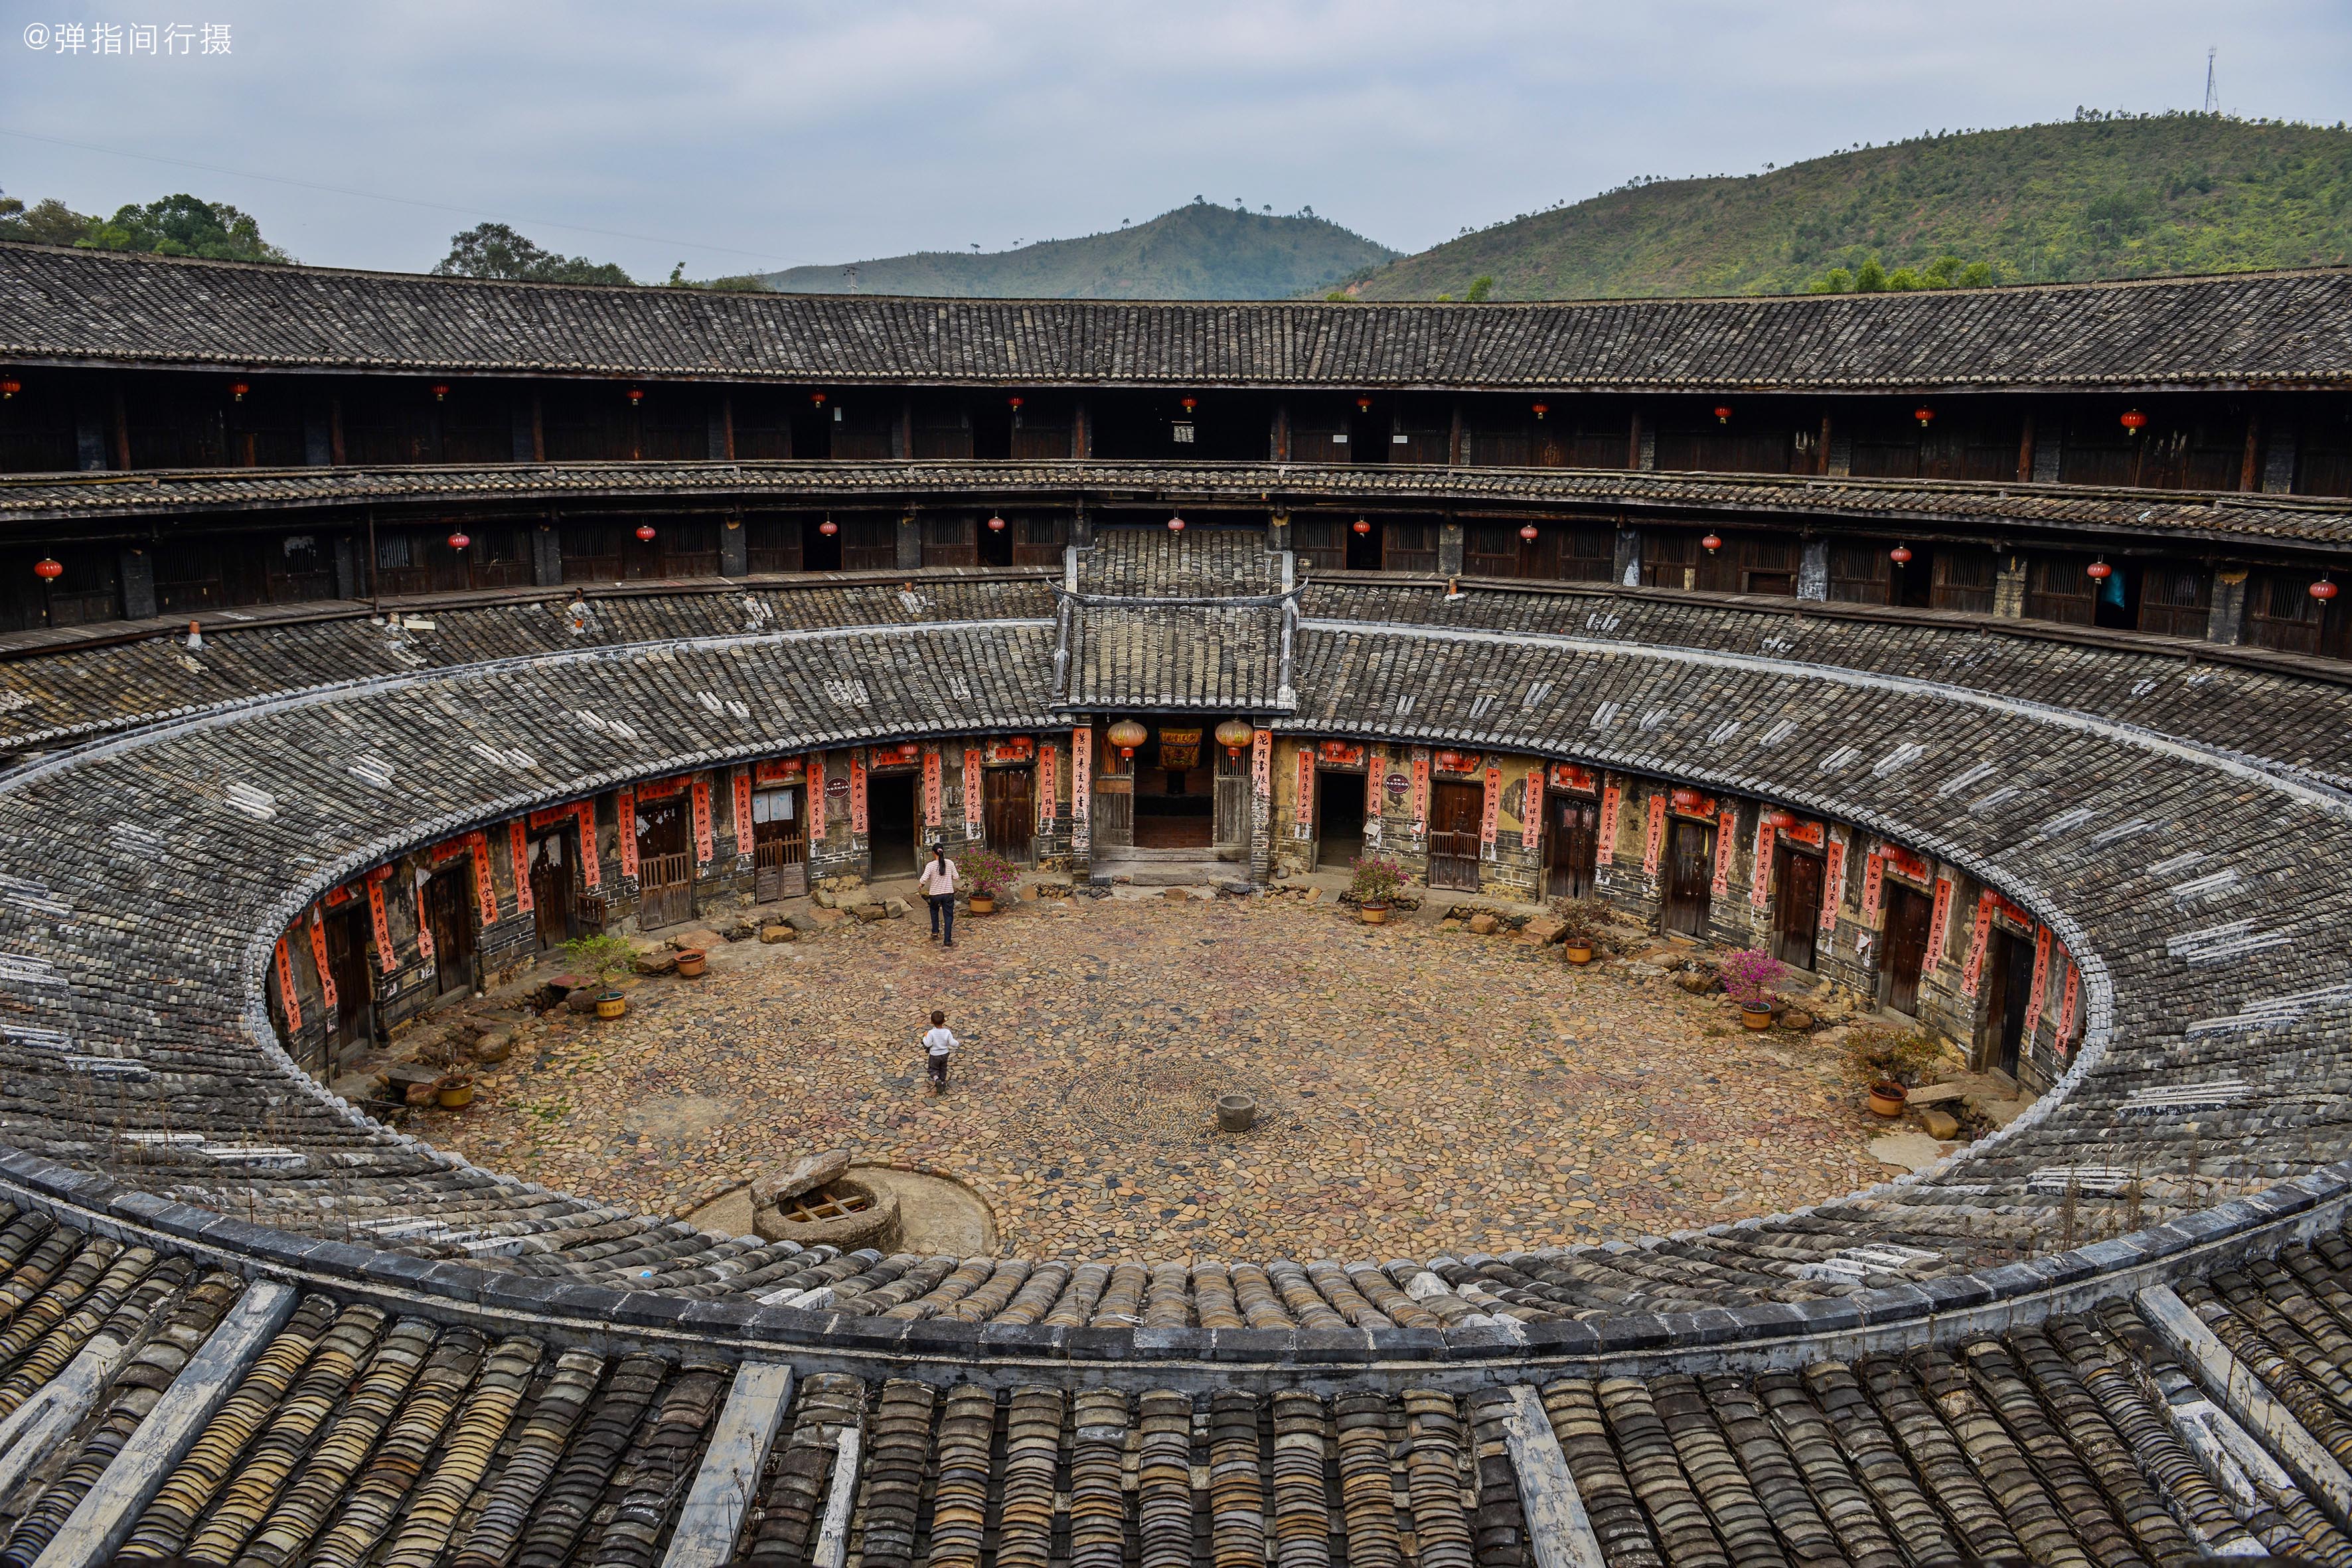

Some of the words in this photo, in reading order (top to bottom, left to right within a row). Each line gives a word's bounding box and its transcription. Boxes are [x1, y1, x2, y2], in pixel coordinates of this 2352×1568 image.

[1414, 765, 1424, 827] 平安二字值千
